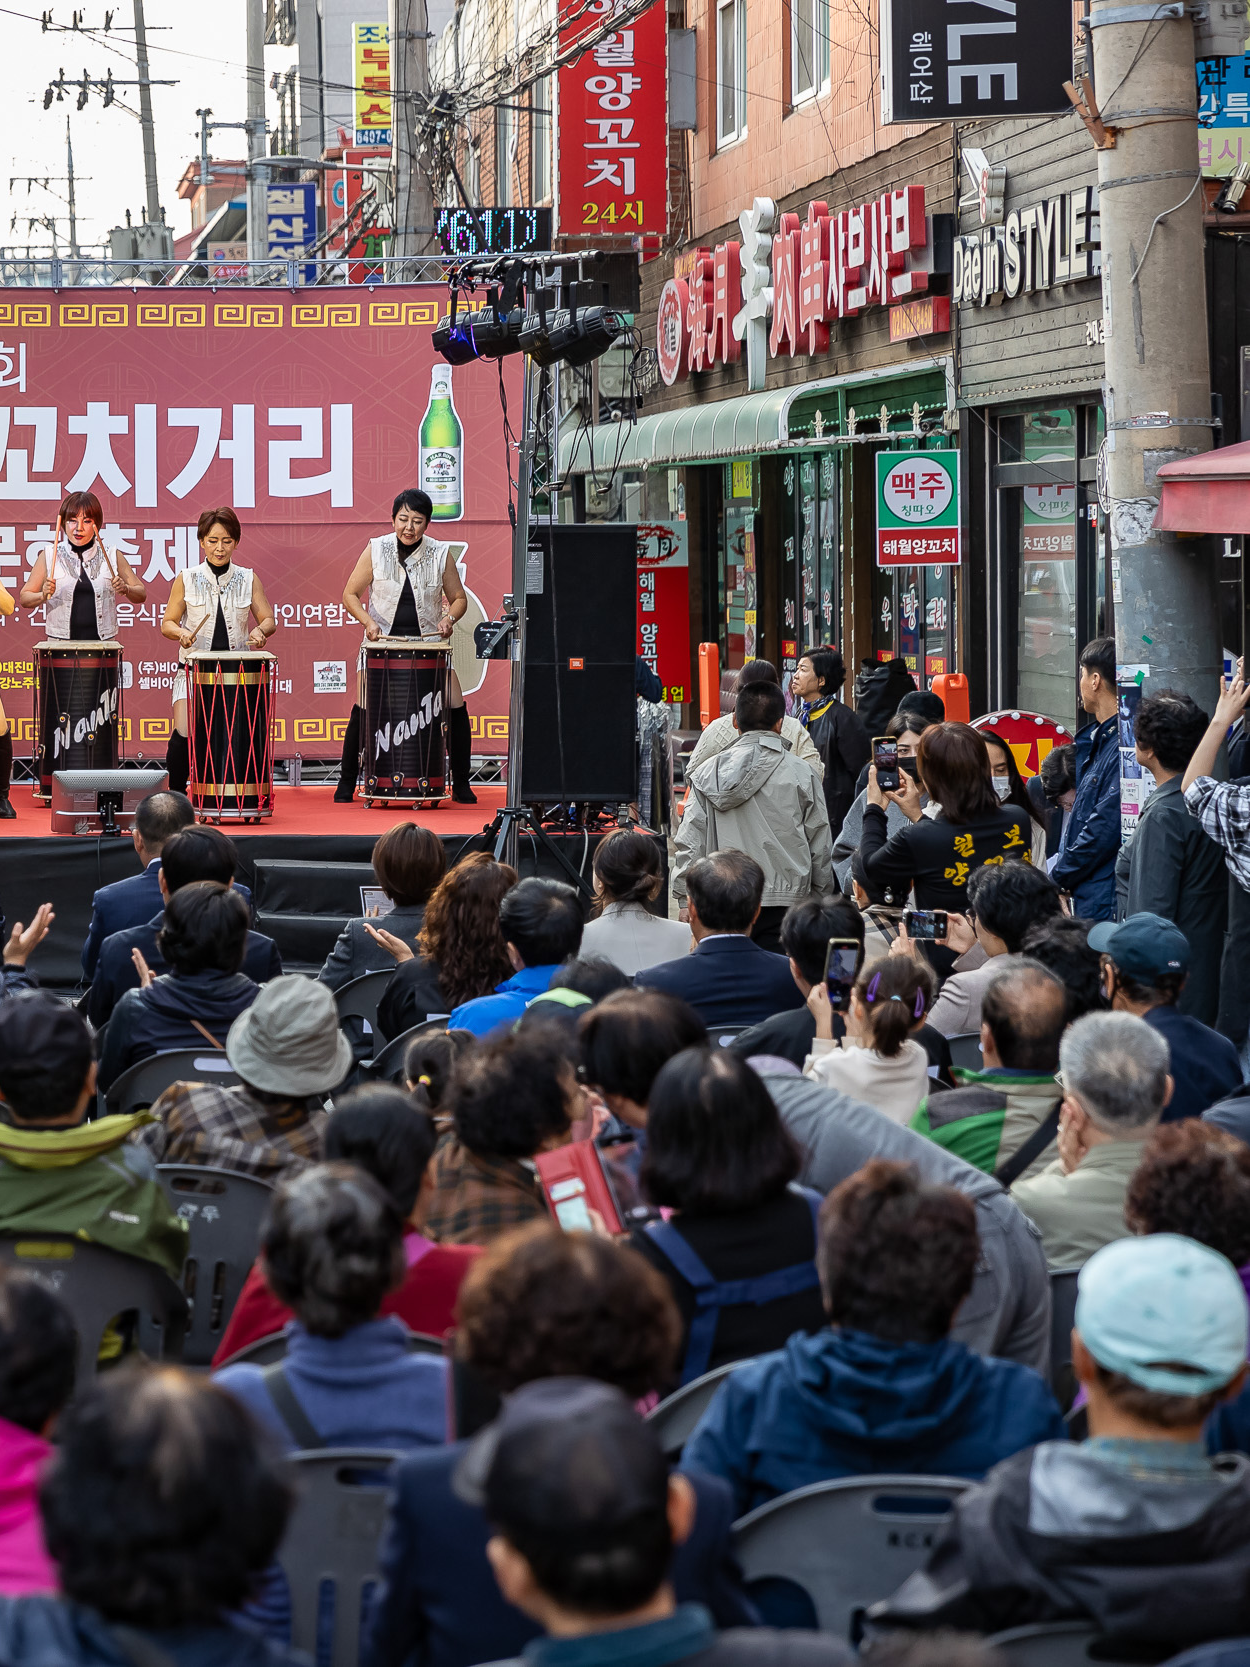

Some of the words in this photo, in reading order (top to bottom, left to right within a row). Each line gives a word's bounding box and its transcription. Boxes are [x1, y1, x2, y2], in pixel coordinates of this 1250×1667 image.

[910, 31, 933, 104] 헤어샵
[582, 201, 644, 226] 24시
[953, 227, 1002, 307] Daejin
[1005, 186, 1090, 298] STYLE
[891, 472, 946, 500] 맥주
[901, 504, 936, 517] 칭따오
[882, 537, 957, 556] 해월양꼬치
[639, 572, 655, 612] 해월
